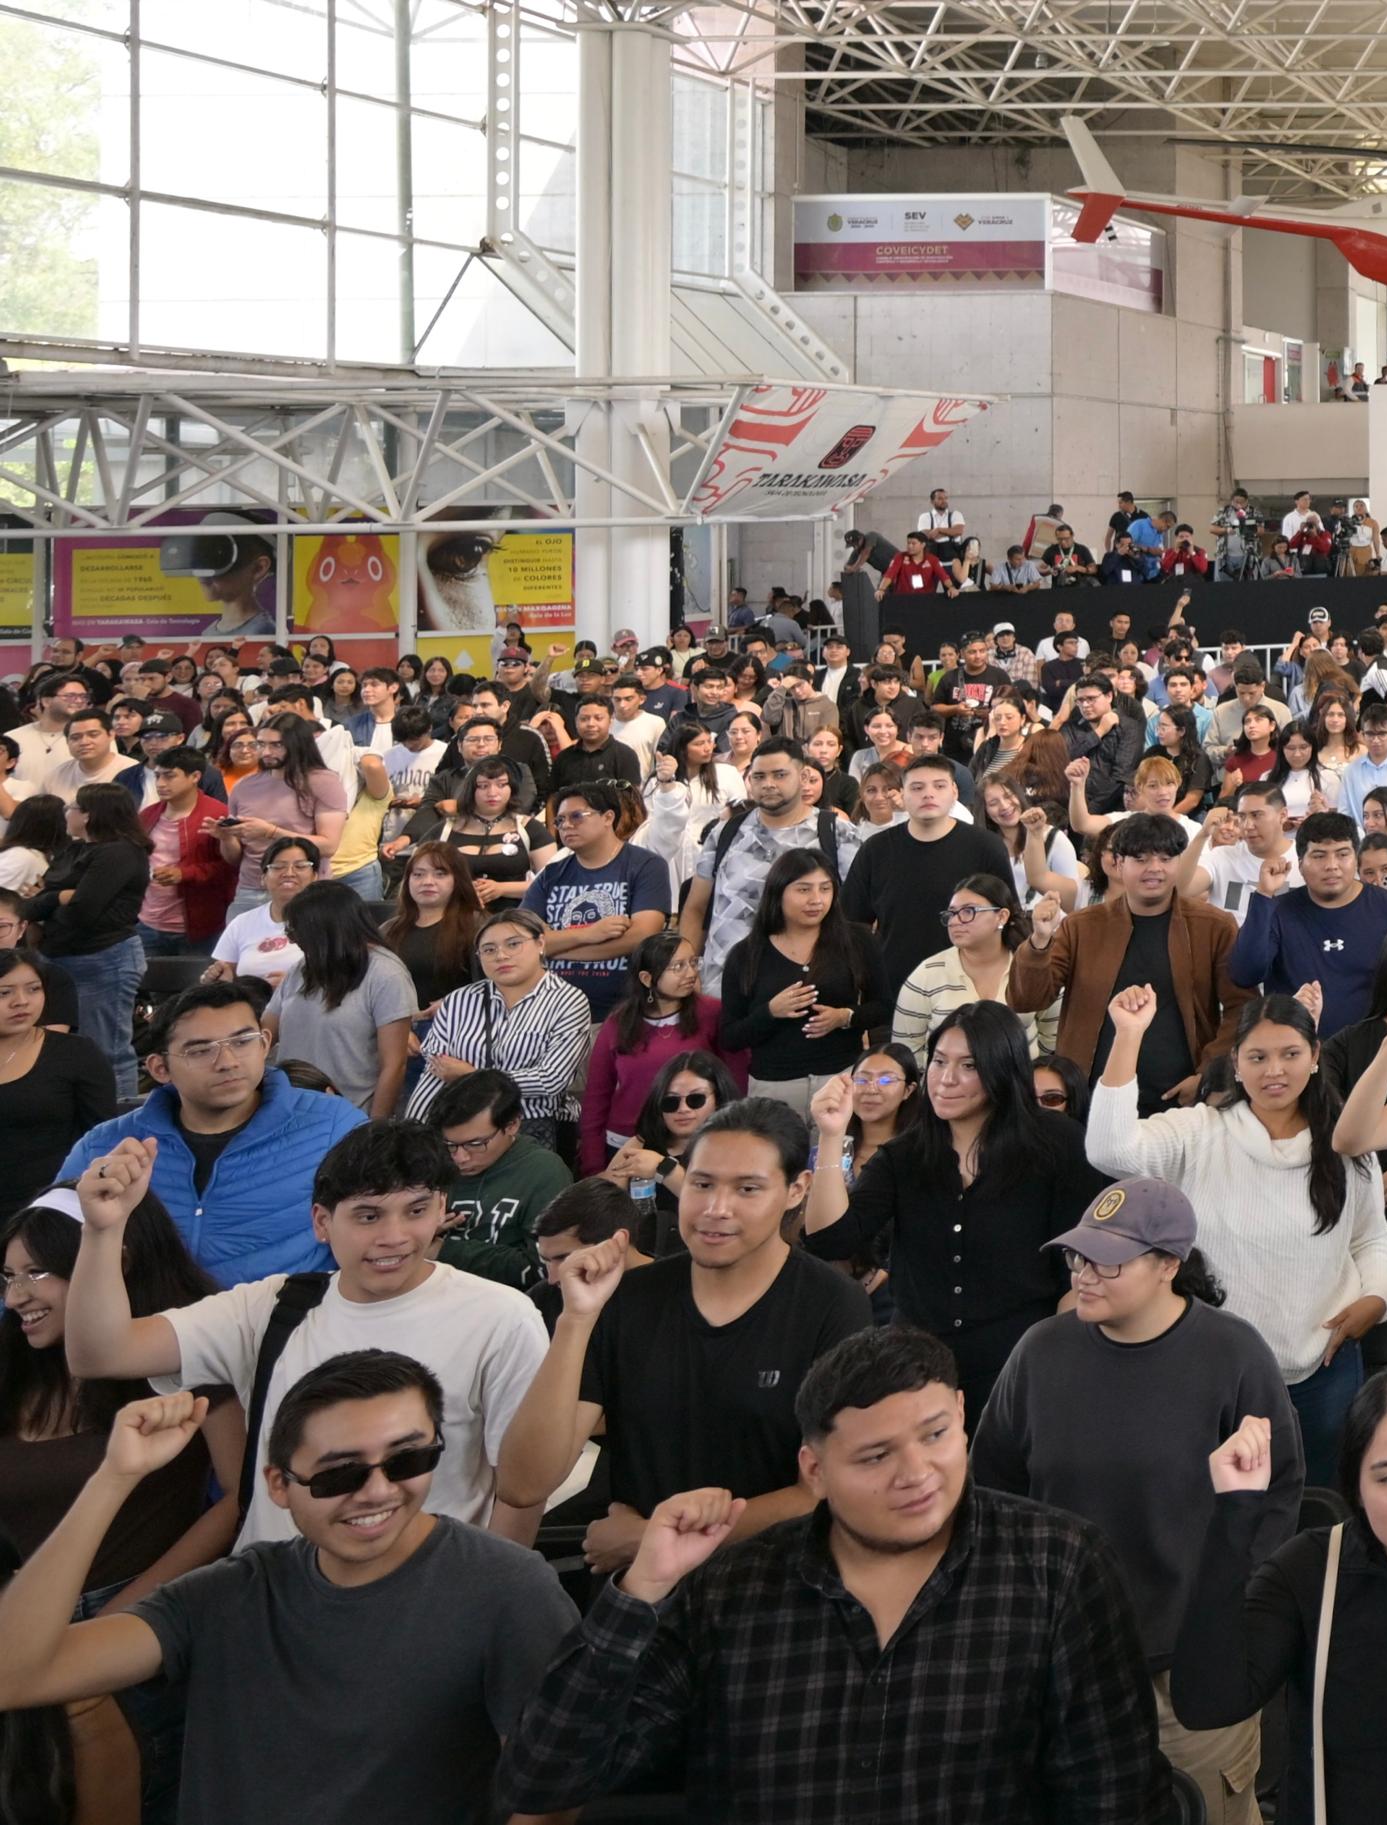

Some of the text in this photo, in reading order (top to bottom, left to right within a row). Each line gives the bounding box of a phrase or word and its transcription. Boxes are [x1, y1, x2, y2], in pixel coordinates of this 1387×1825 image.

[904, 211, 927, 220] SEV
[876, 245, 949, 256] COVEICYDET
[751, 473, 868, 488] TARAKAWASA
[520, 565, 562, 573] MILLONES
[523, 574, 562, 582] COLORES
[547, 881, 628, 904] STAY TRUE
